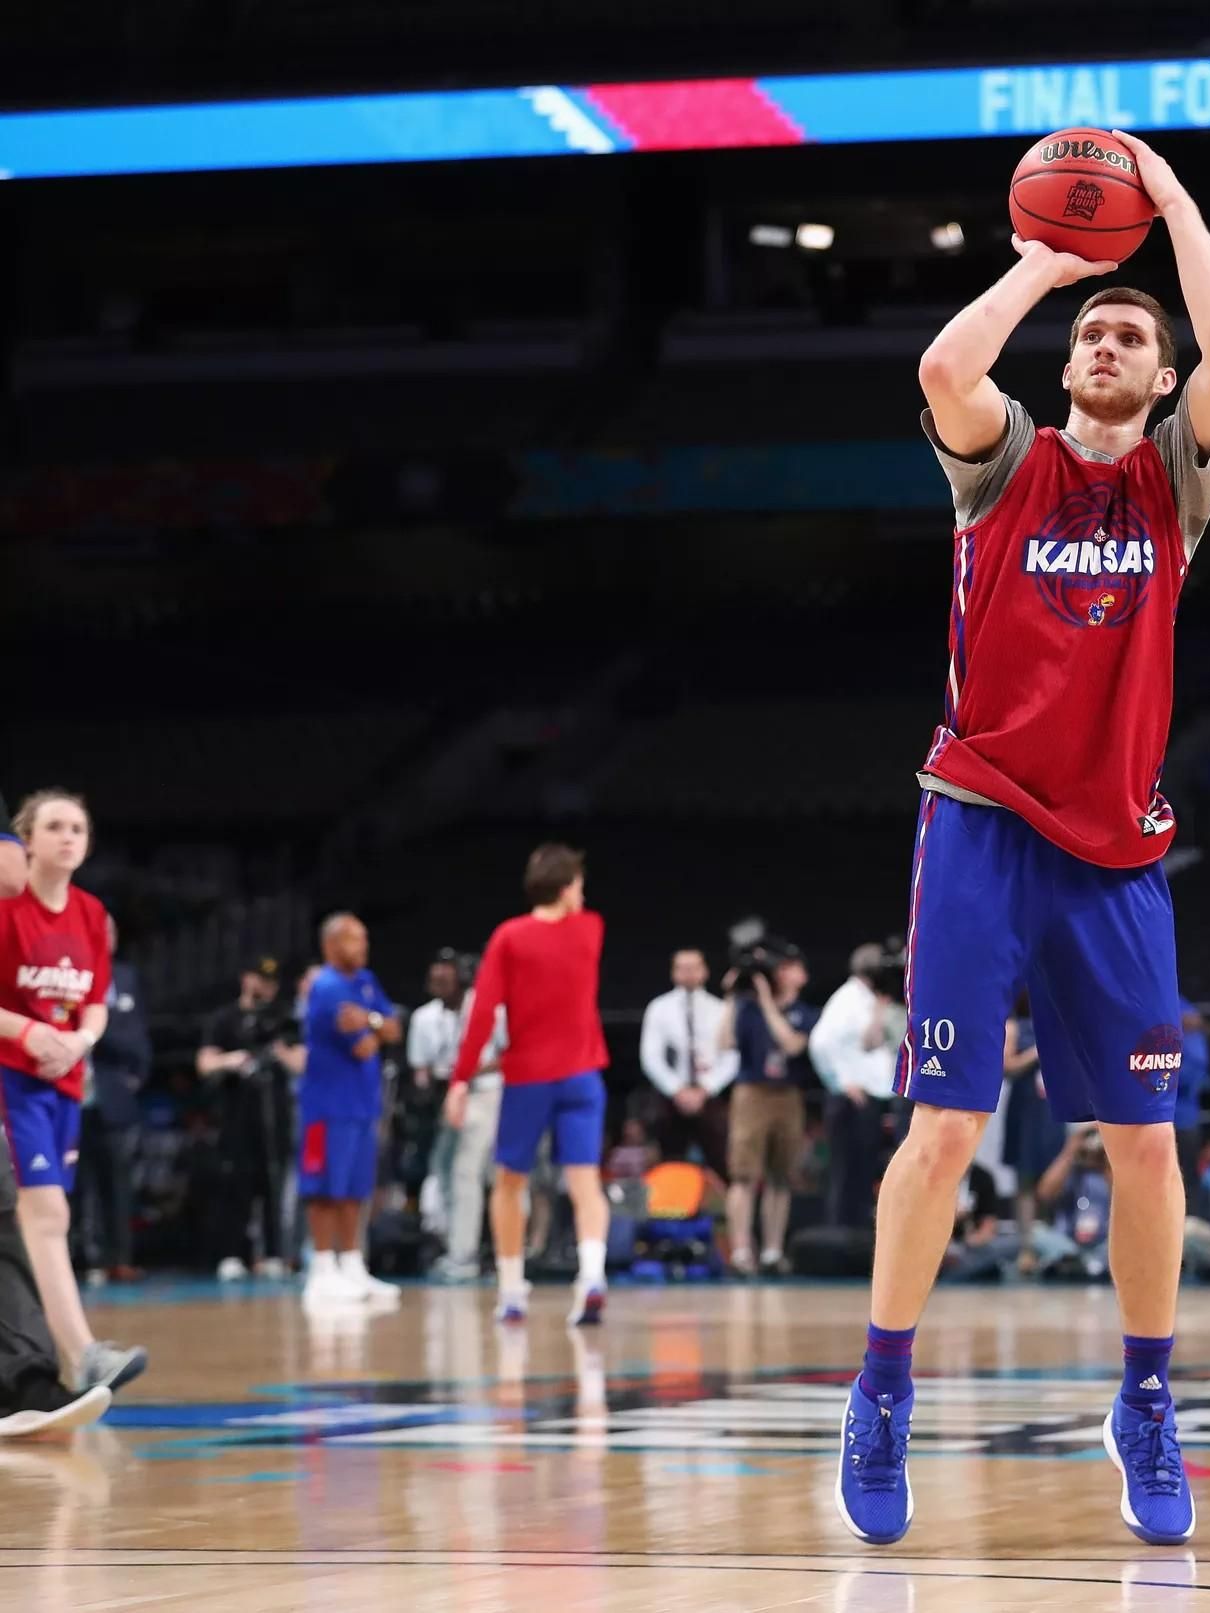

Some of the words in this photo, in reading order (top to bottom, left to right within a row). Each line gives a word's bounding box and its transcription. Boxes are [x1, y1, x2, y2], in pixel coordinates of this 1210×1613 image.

[981, 66, 1135, 131] FINAL
[1040, 140, 1137, 177] Wilson
[1025, 539, 1155, 577] KANSAS
[920, 1017, 955, 1051] 10
[920, 1067, 947, 1077] adidas
